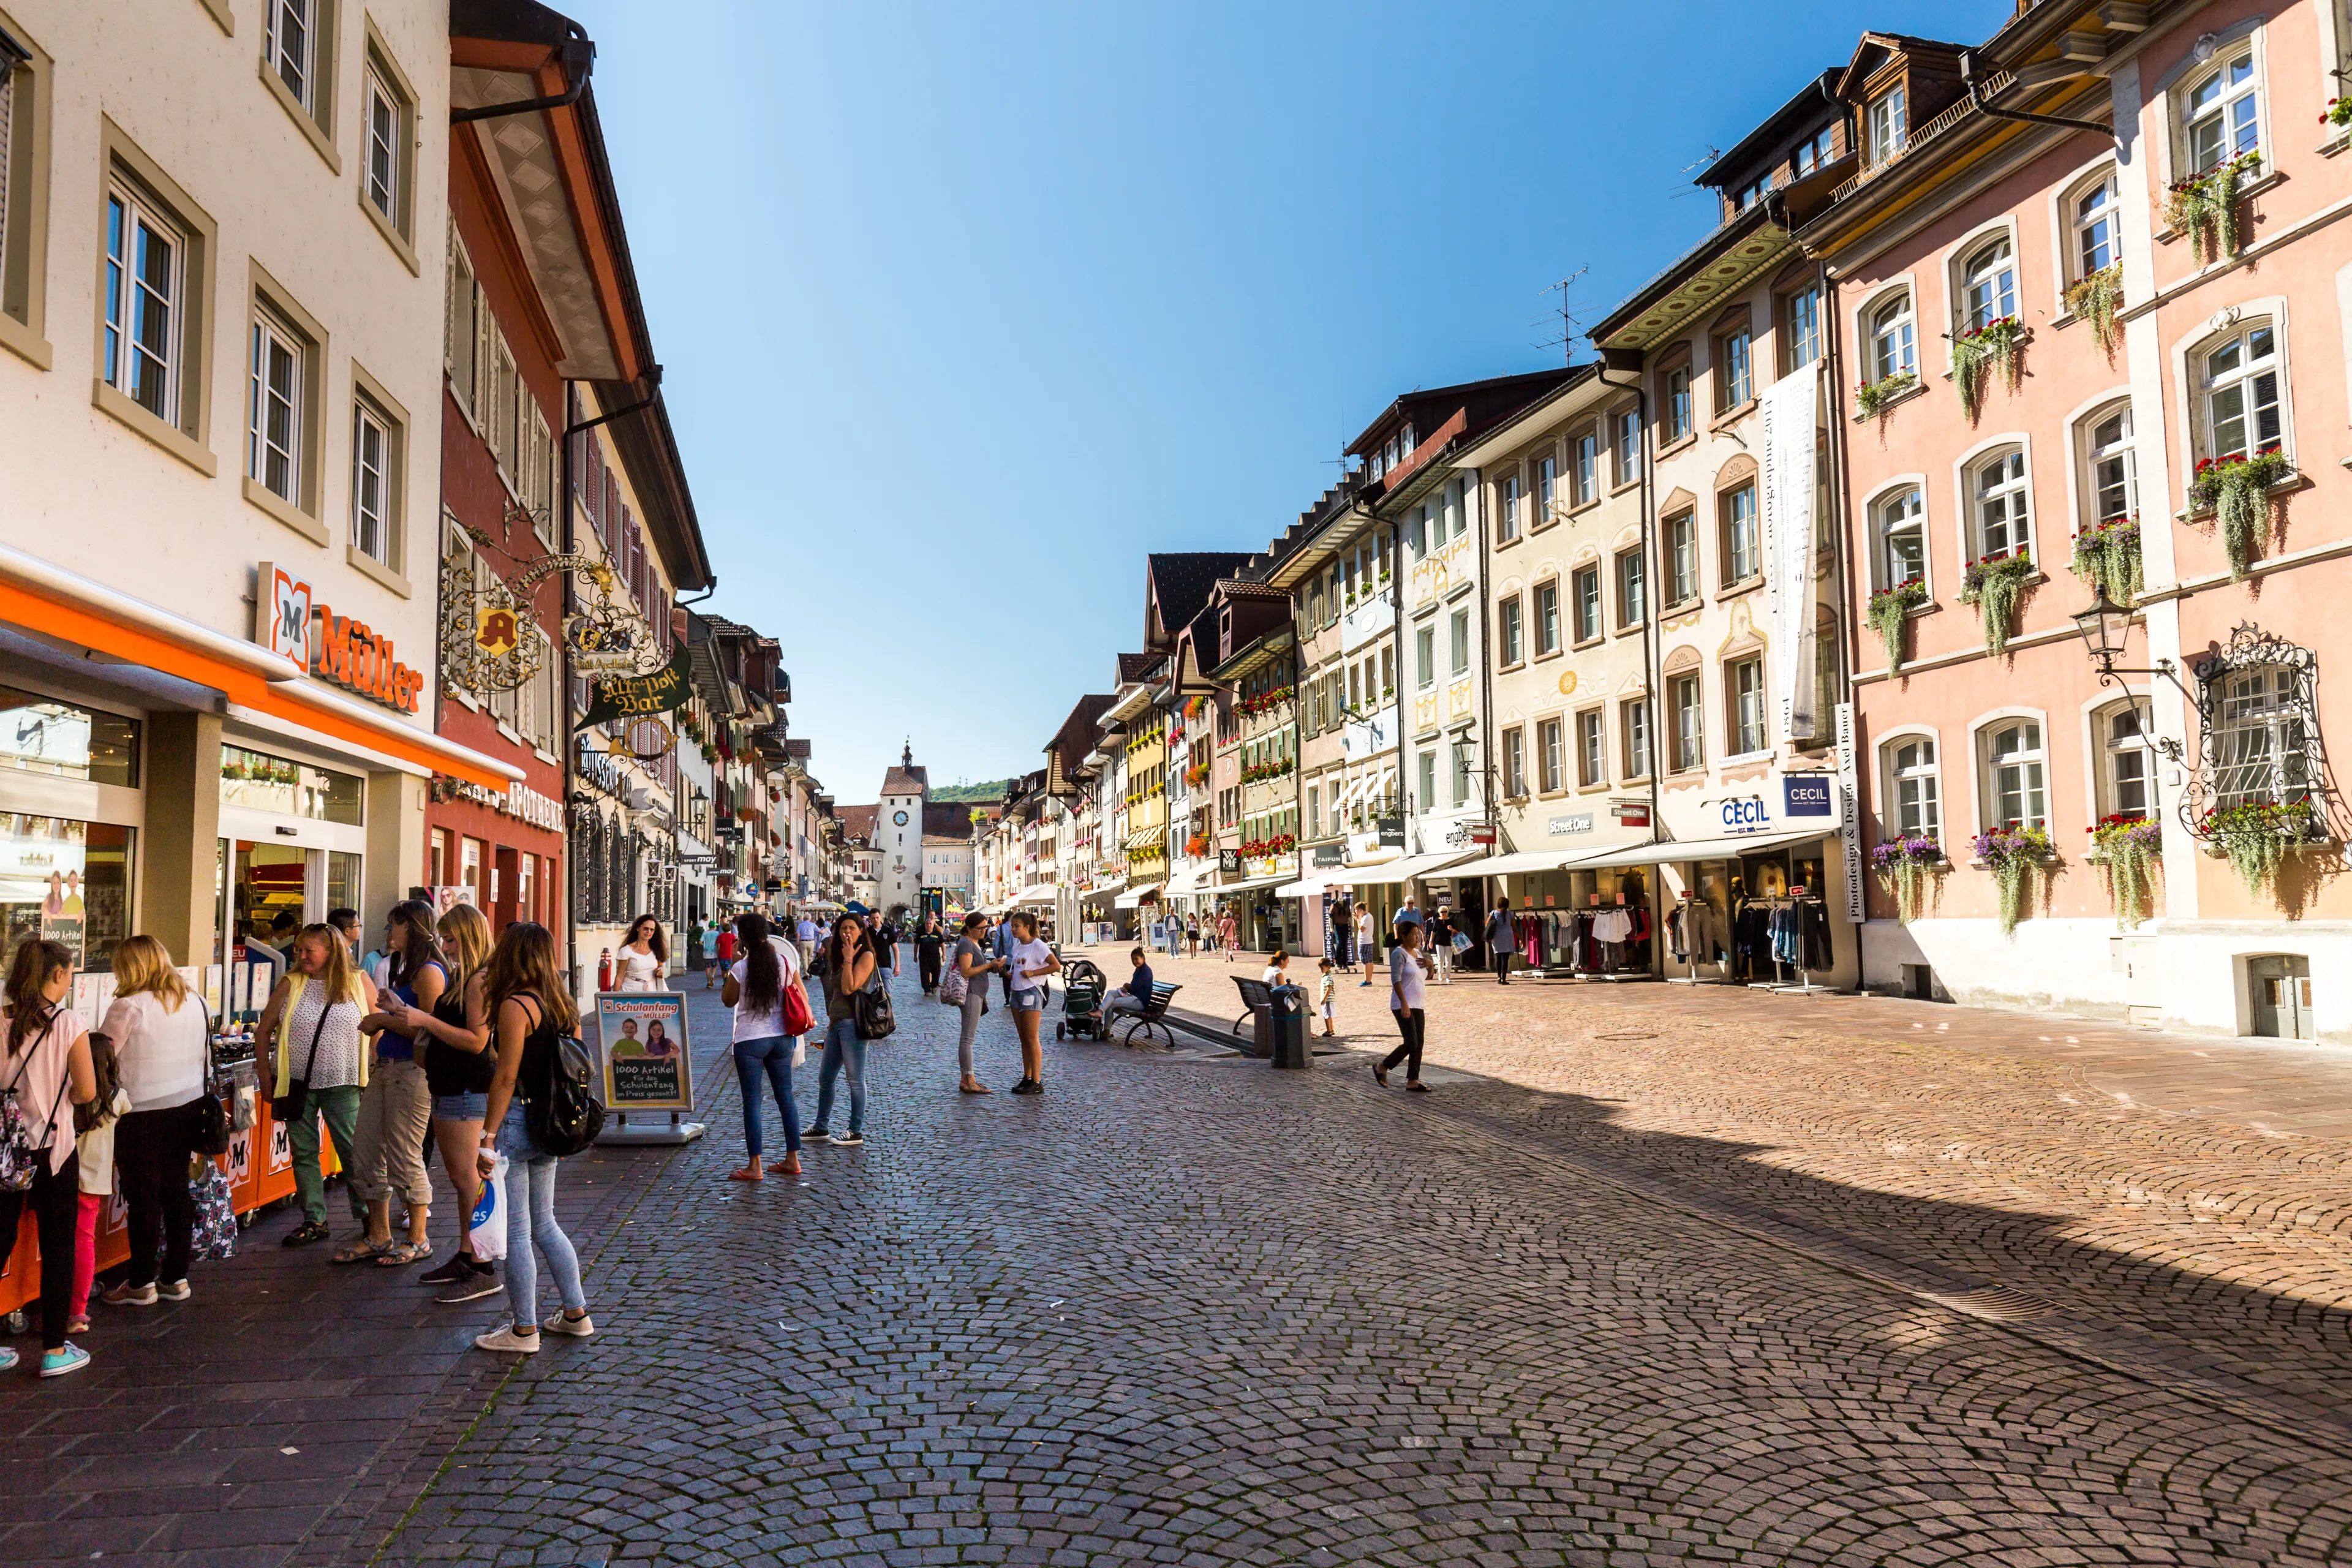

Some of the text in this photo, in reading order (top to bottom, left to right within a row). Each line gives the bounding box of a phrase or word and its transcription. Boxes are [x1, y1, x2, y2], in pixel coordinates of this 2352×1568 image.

[282, 599, 302, 644] M
[477, 611, 517, 647] A
[318, 604, 423, 713] Müller
[577, 660, 594, 669] Rats
[616, 694, 664, 717] Bar
[1841, 707, 1849, 743] Bauer
[1842, 748, 1851, 774] Axel
[1790, 788, 1827, 800] CECIL
[1844, 783, 1855, 823] Design
[1723, 801, 1770, 825] CECIL
[1549, 818, 1591, 834] Street One
[1845, 828, 1855, 839] &
[1222, 850, 1237, 868] WMF
[1848, 843, 1860, 918] Photodesign
[45, 930, 81, 941] 1000 Artikel
[616, 1002, 677, 1013] Schulanfang
[616, 1065, 674, 1074] 1000 Artikel
[620, 1081, 674, 1090] Schulanfang
[647, 1090, 677, 1099] gesenkt!
[276, 1129, 288, 1155] M
[232, 1140, 246, 1169] M
